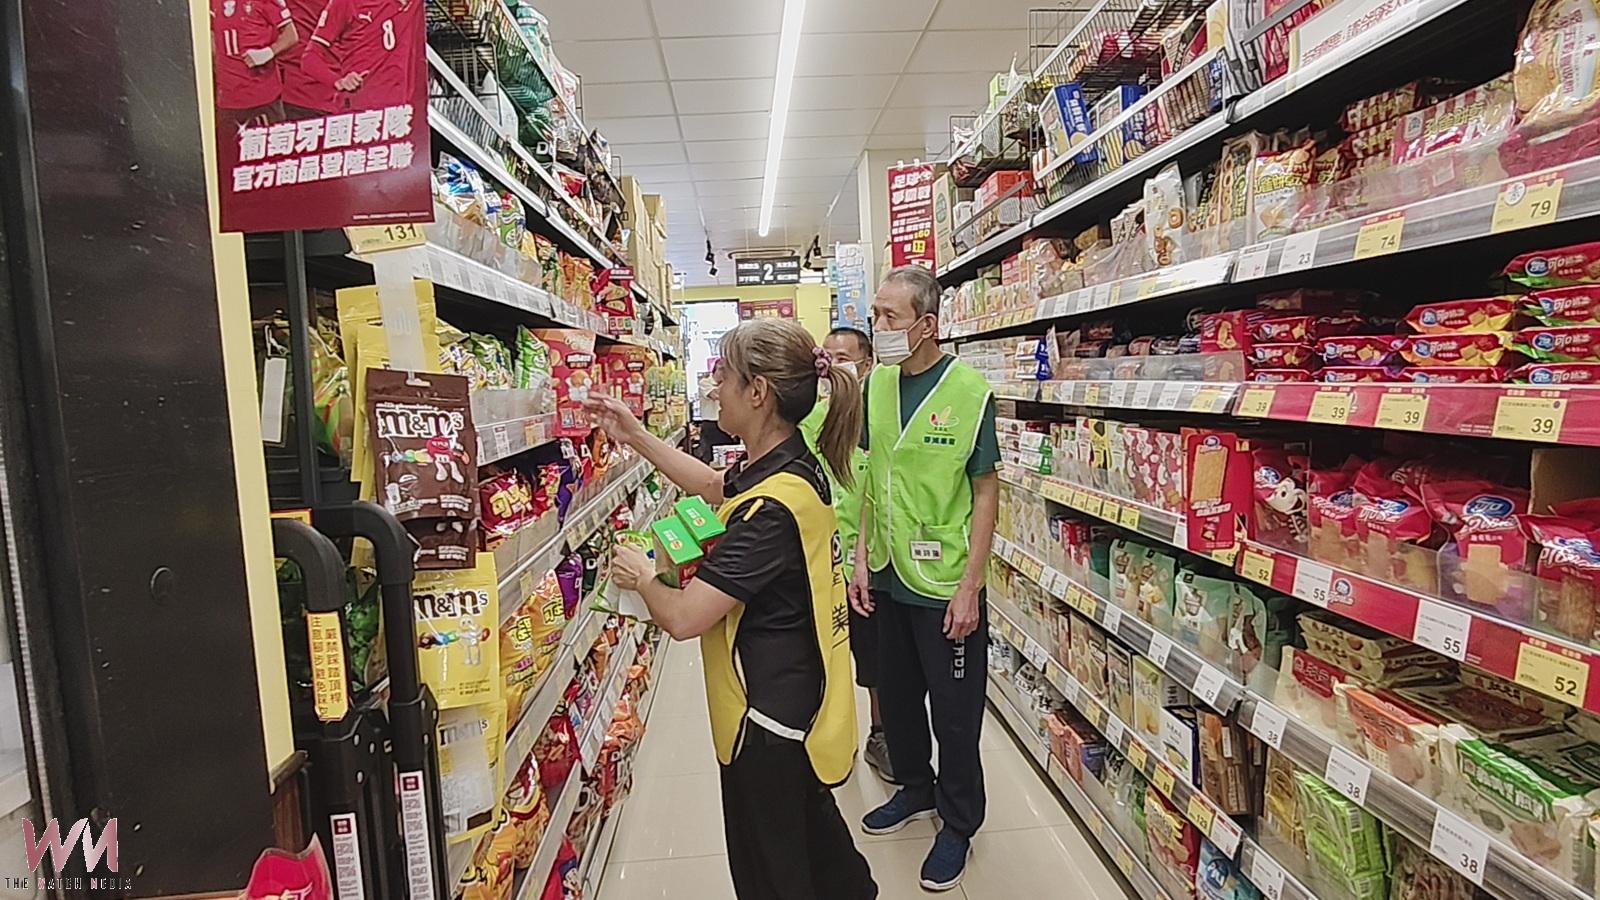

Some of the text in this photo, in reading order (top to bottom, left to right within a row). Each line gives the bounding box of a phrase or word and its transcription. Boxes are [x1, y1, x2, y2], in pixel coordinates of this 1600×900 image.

[383, 19, 396, 50] 8
[239, 104, 414, 161] 葡萄牙國家隊
[233, 141, 414, 192] 官方商品登陸全聯
[1531, 200, 1551, 218] 79
[385, 224, 418, 241] 131
[1381, 235, 1396, 249] 74
[1300, 253, 1311, 265] 23
[763, 263, 774, 281] 2
[1256, 401, 1267, 412] 39
[1331, 406, 1345, 419] 39
[1404, 410, 1420, 424] 39
[1531, 418, 1553, 434] 39
[1258, 569, 1269, 580] 52
[1313, 588, 1326, 601] 55
[1443, 637, 1461, 654] 55
[1554, 676, 1577, 697] 52
[1346, 782, 1360, 799] 38
[1460, 853, 1478, 874] 38
